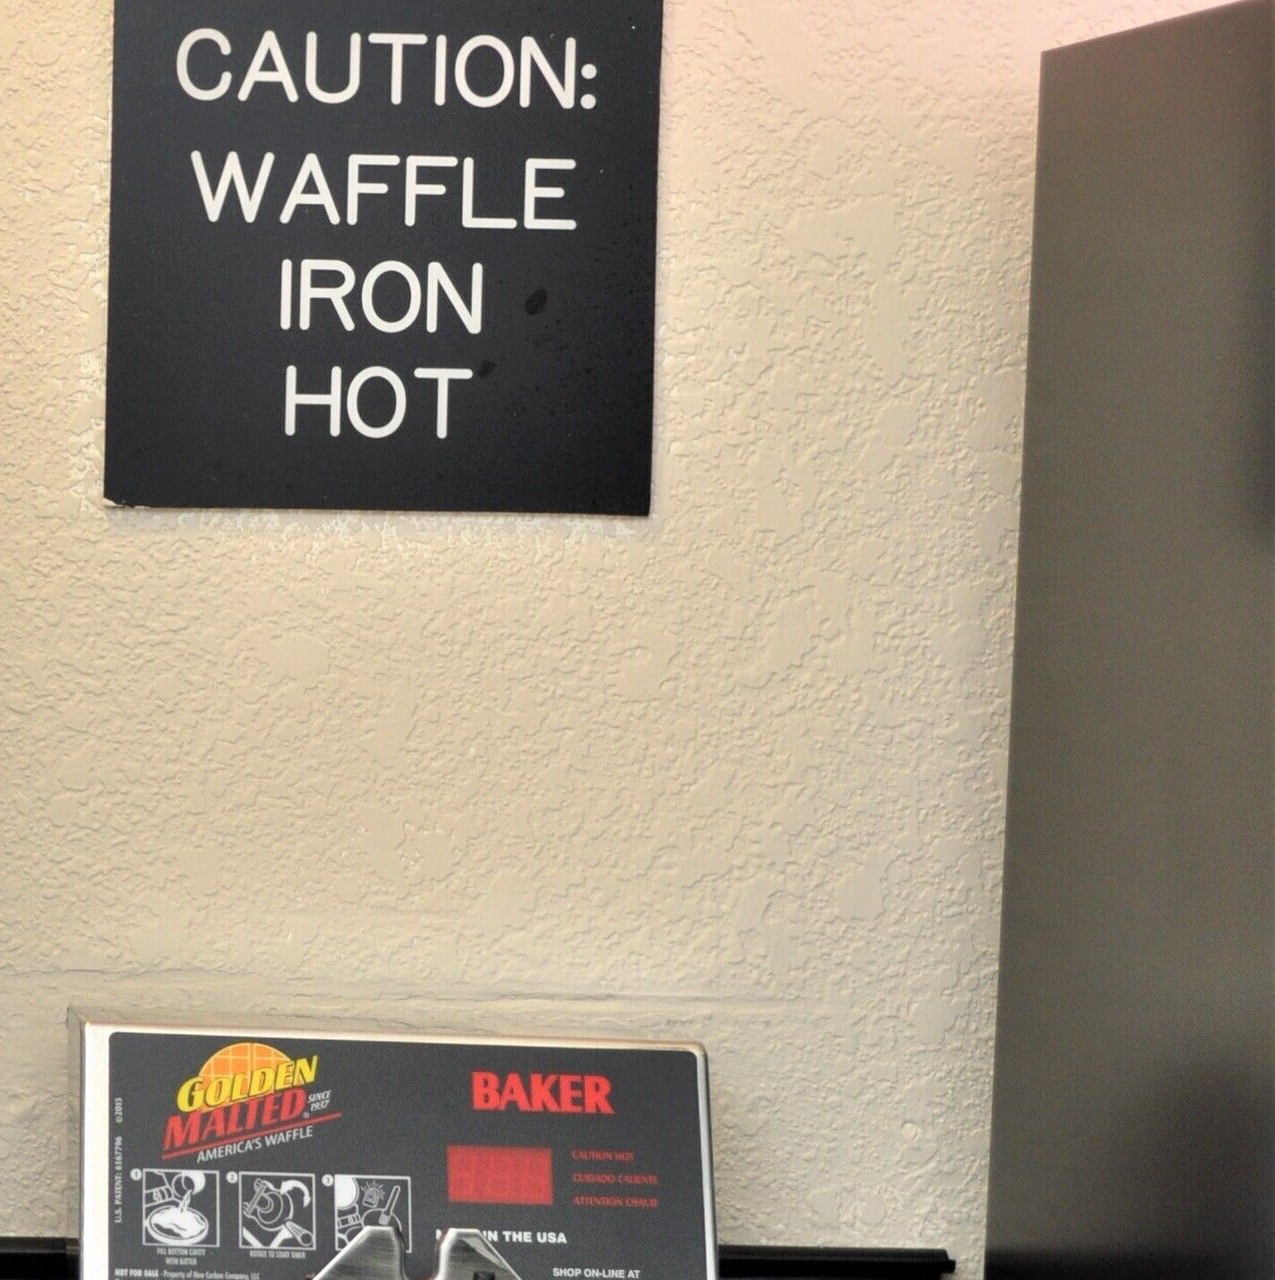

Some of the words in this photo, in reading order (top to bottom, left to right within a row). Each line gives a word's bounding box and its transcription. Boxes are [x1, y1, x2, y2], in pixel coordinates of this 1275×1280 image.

[176, 27, 597, 109] CAUTION:
[191, 150, 577, 230] WAFFLE
[280, 259, 483, 334] IRON
[284, 365, 473, 439] HOT
[177, 1054, 319, 1113] GOLDEN
[307, 1089, 332, 1104] SINCE
[471, 1071, 616, 1115] BAKER
[162, 1086, 309, 1151] MALTED
[310, 1099, 330, 1112] 1937
[196, 1137, 263, 1164] AMERICA'S
[265, 1125, 314, 1147] WAFFLE
[572, 1150, 613, 1161] CAUTION
[615, 1151, 635, 1162] HOT
[114, 1173, 123, 1205] PATENT:
[572, 1196, 623, 1207] ATTENTION
[502, 1231, 532, 1243] THE
[537, 1232, 568, 1244] USA
[114, 1269, 128, 1277] NOT
[129, 1269, 143, 1277] FOR
[144, 1269, 159, 1278] SALE
[163, 1271, 186, 1280] Property
[553, 1267, 582, 1278] SHOP
[584, 1268, 625, 1279] ON-LINE
[627, 1269, 640, 1279] AT
